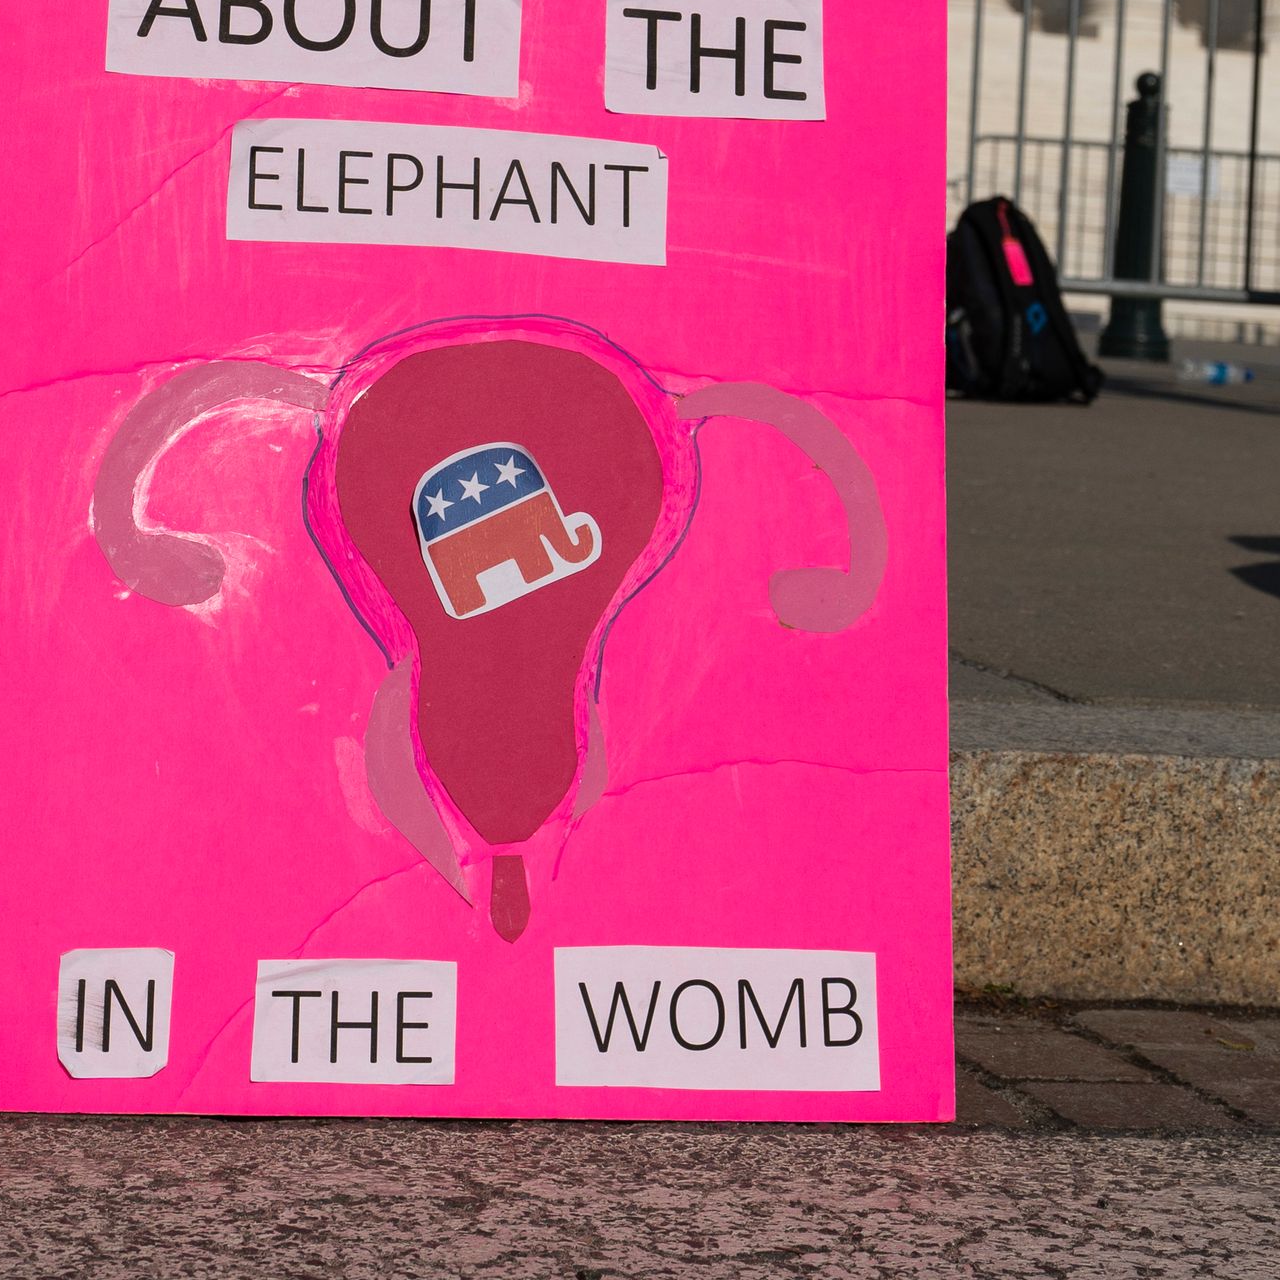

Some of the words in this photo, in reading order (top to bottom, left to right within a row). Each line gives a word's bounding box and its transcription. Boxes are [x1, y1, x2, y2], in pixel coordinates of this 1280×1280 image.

[621, 7, 808, 102] THE
[247, 145, 650, 229] ELEPHANT
[74, 977, 157, 1054] IN
[271, 989, 434, 1065] THE
[578, 976, 865, 1054] WOMB
